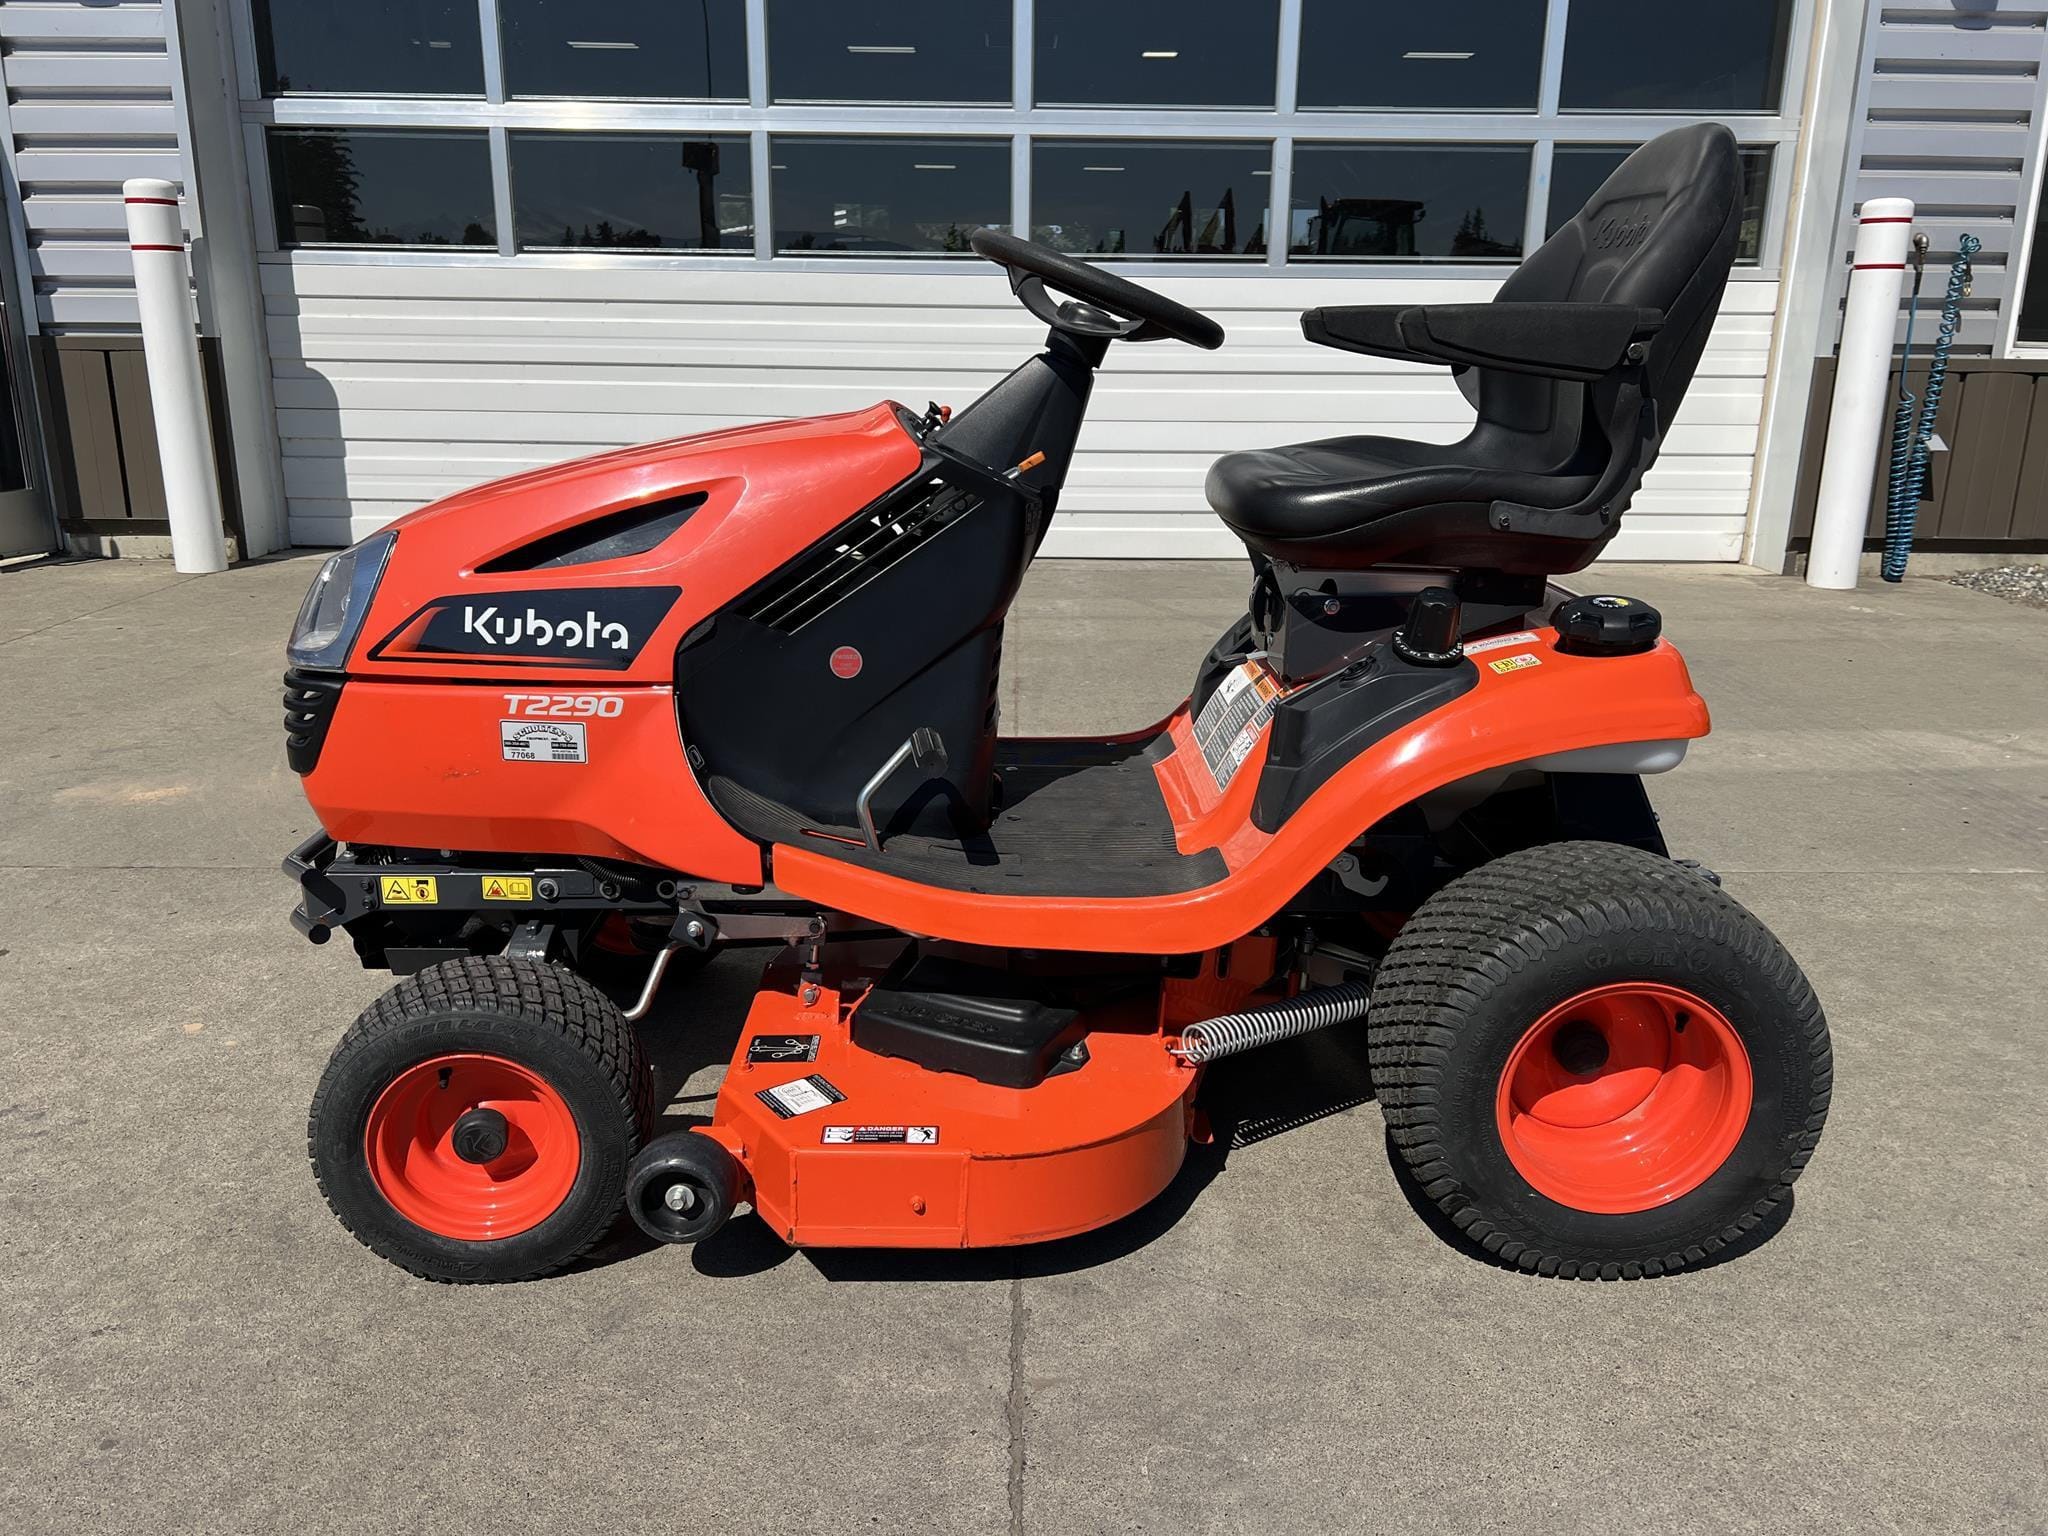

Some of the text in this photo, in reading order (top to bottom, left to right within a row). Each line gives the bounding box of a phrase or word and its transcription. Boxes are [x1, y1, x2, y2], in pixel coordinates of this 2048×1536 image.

[464, 605, 630, 650] Kubota
[503, 694, 624, 718] T2290
[511, 751, 536, 760] 77068
